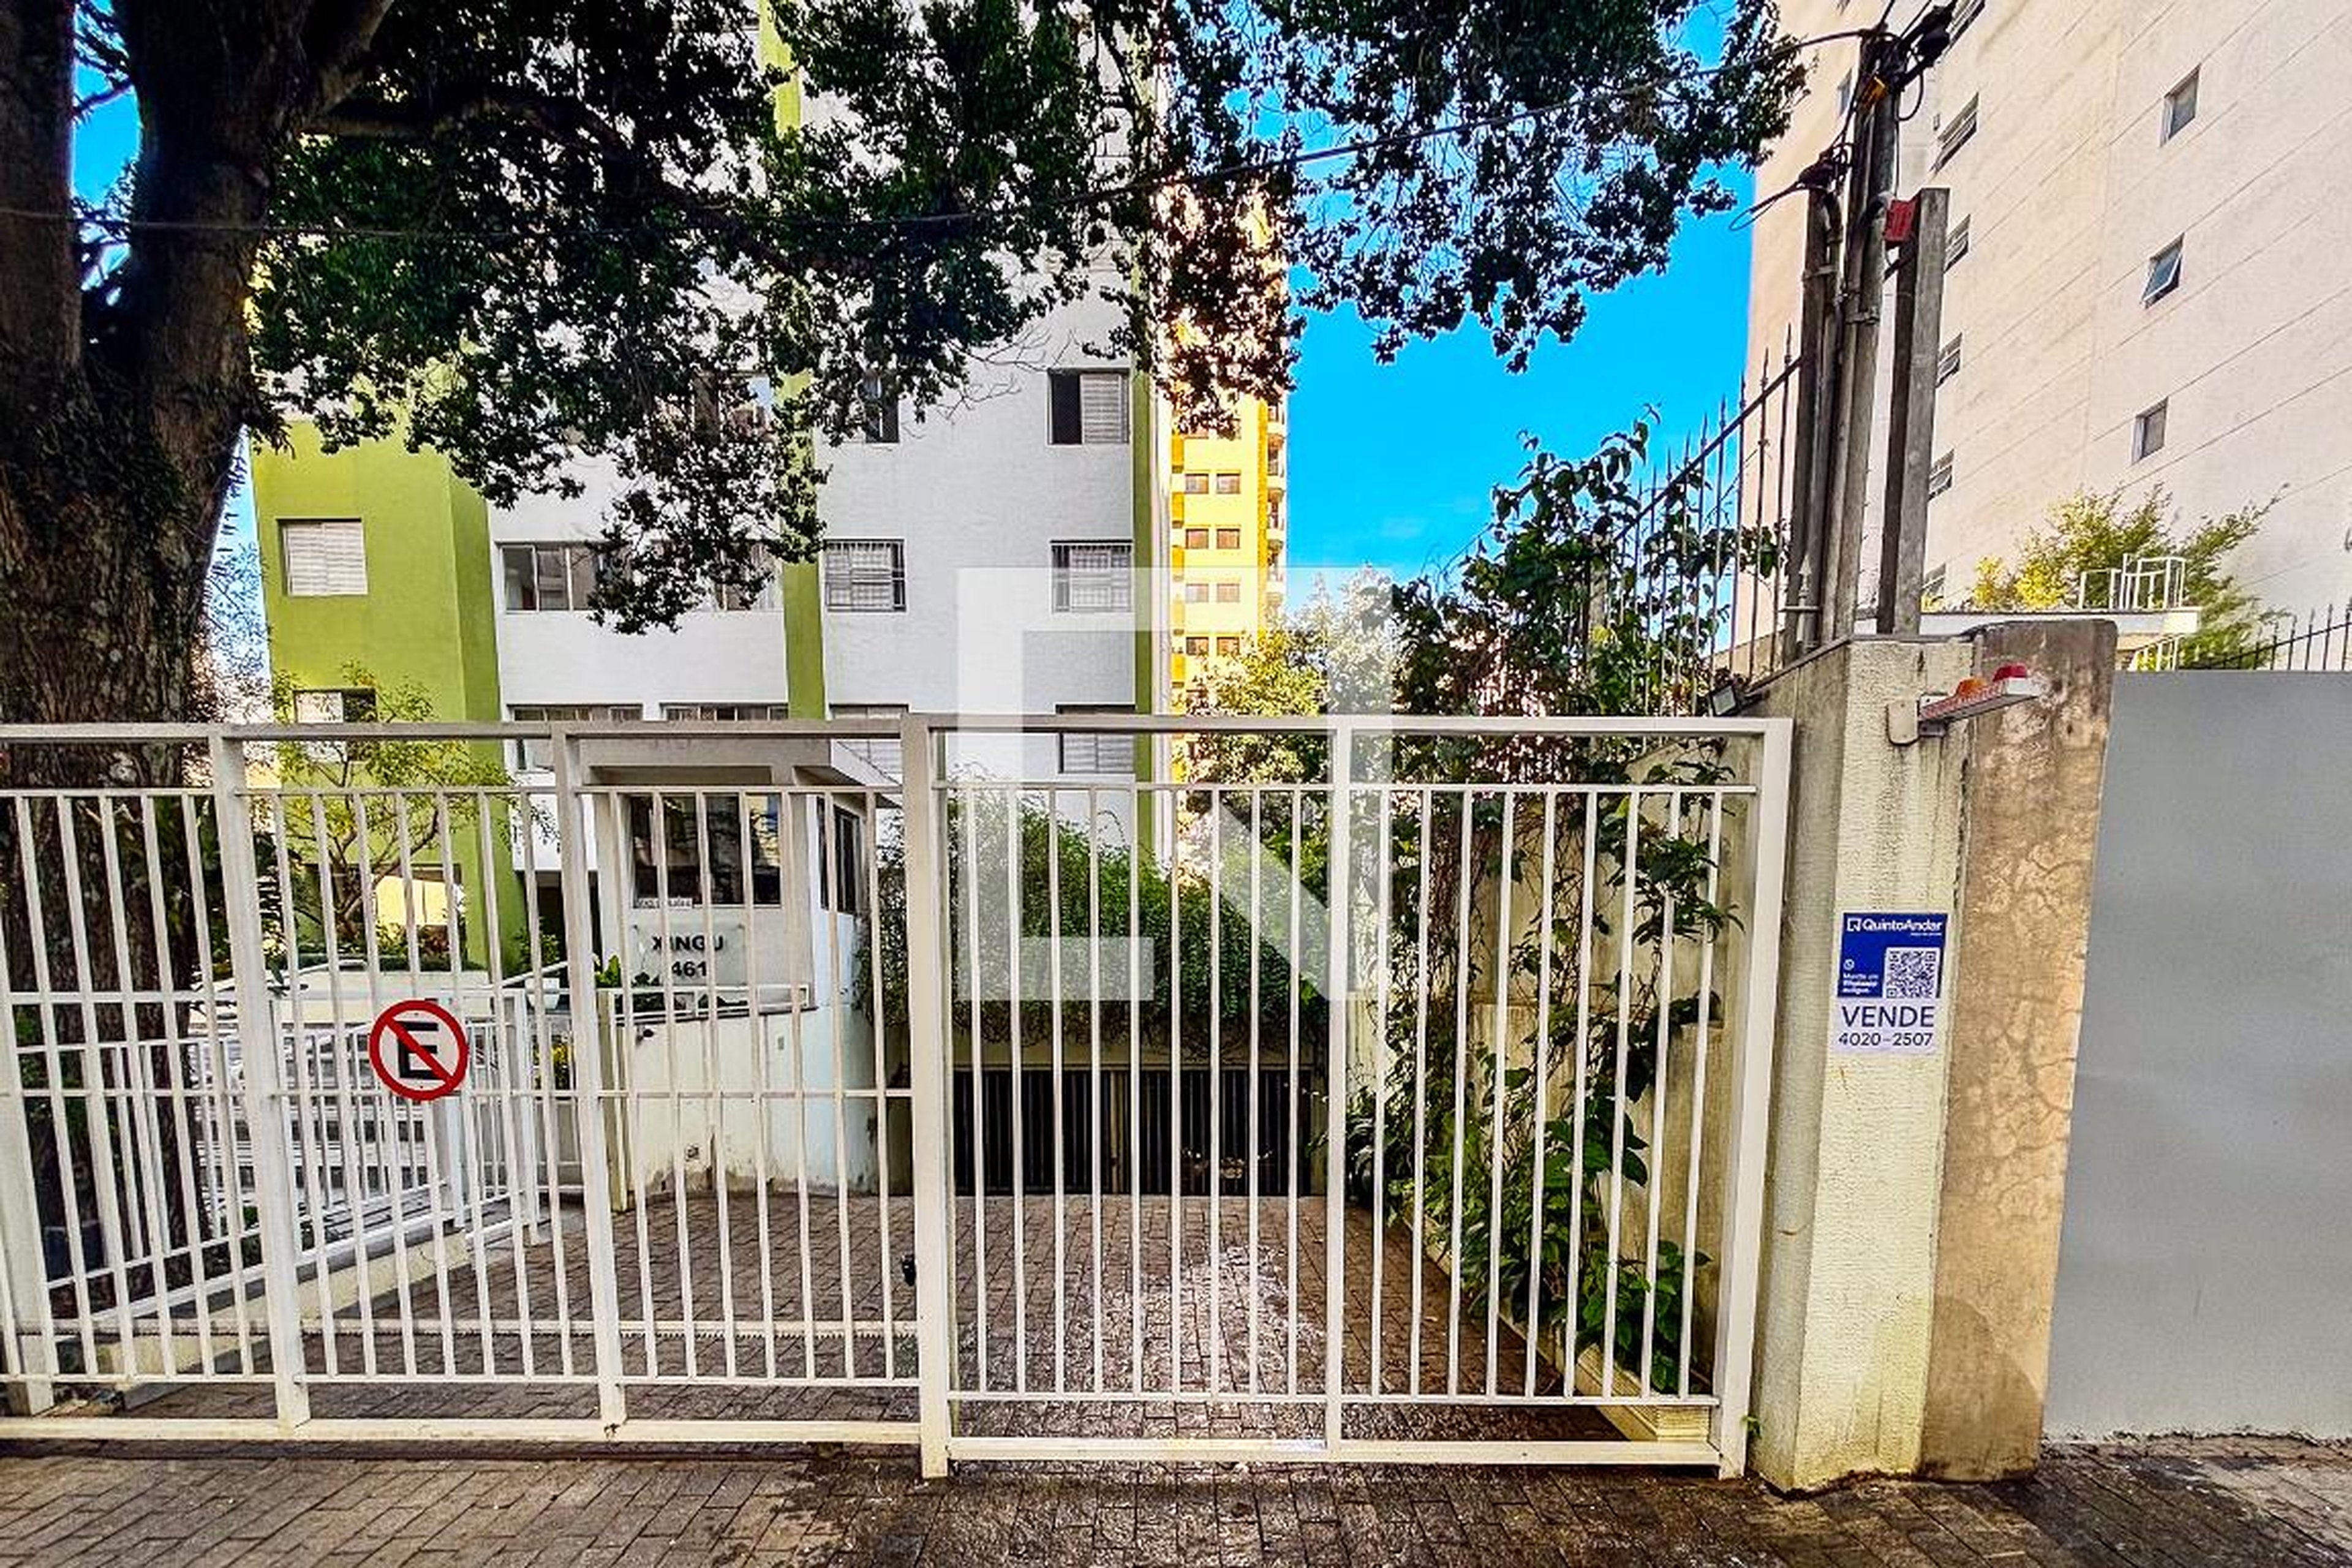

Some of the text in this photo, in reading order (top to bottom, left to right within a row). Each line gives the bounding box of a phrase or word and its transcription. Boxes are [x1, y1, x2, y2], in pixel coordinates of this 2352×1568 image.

[1862, 918, 1943, 932] QuintoAndar
[652, 935, 723, 951] XINGU
[671, 961, 707, 977] 461
[1842, 1006, 1935, 1028] VENDE
[1838, 1033, 1934, 1046] 4020-2507
